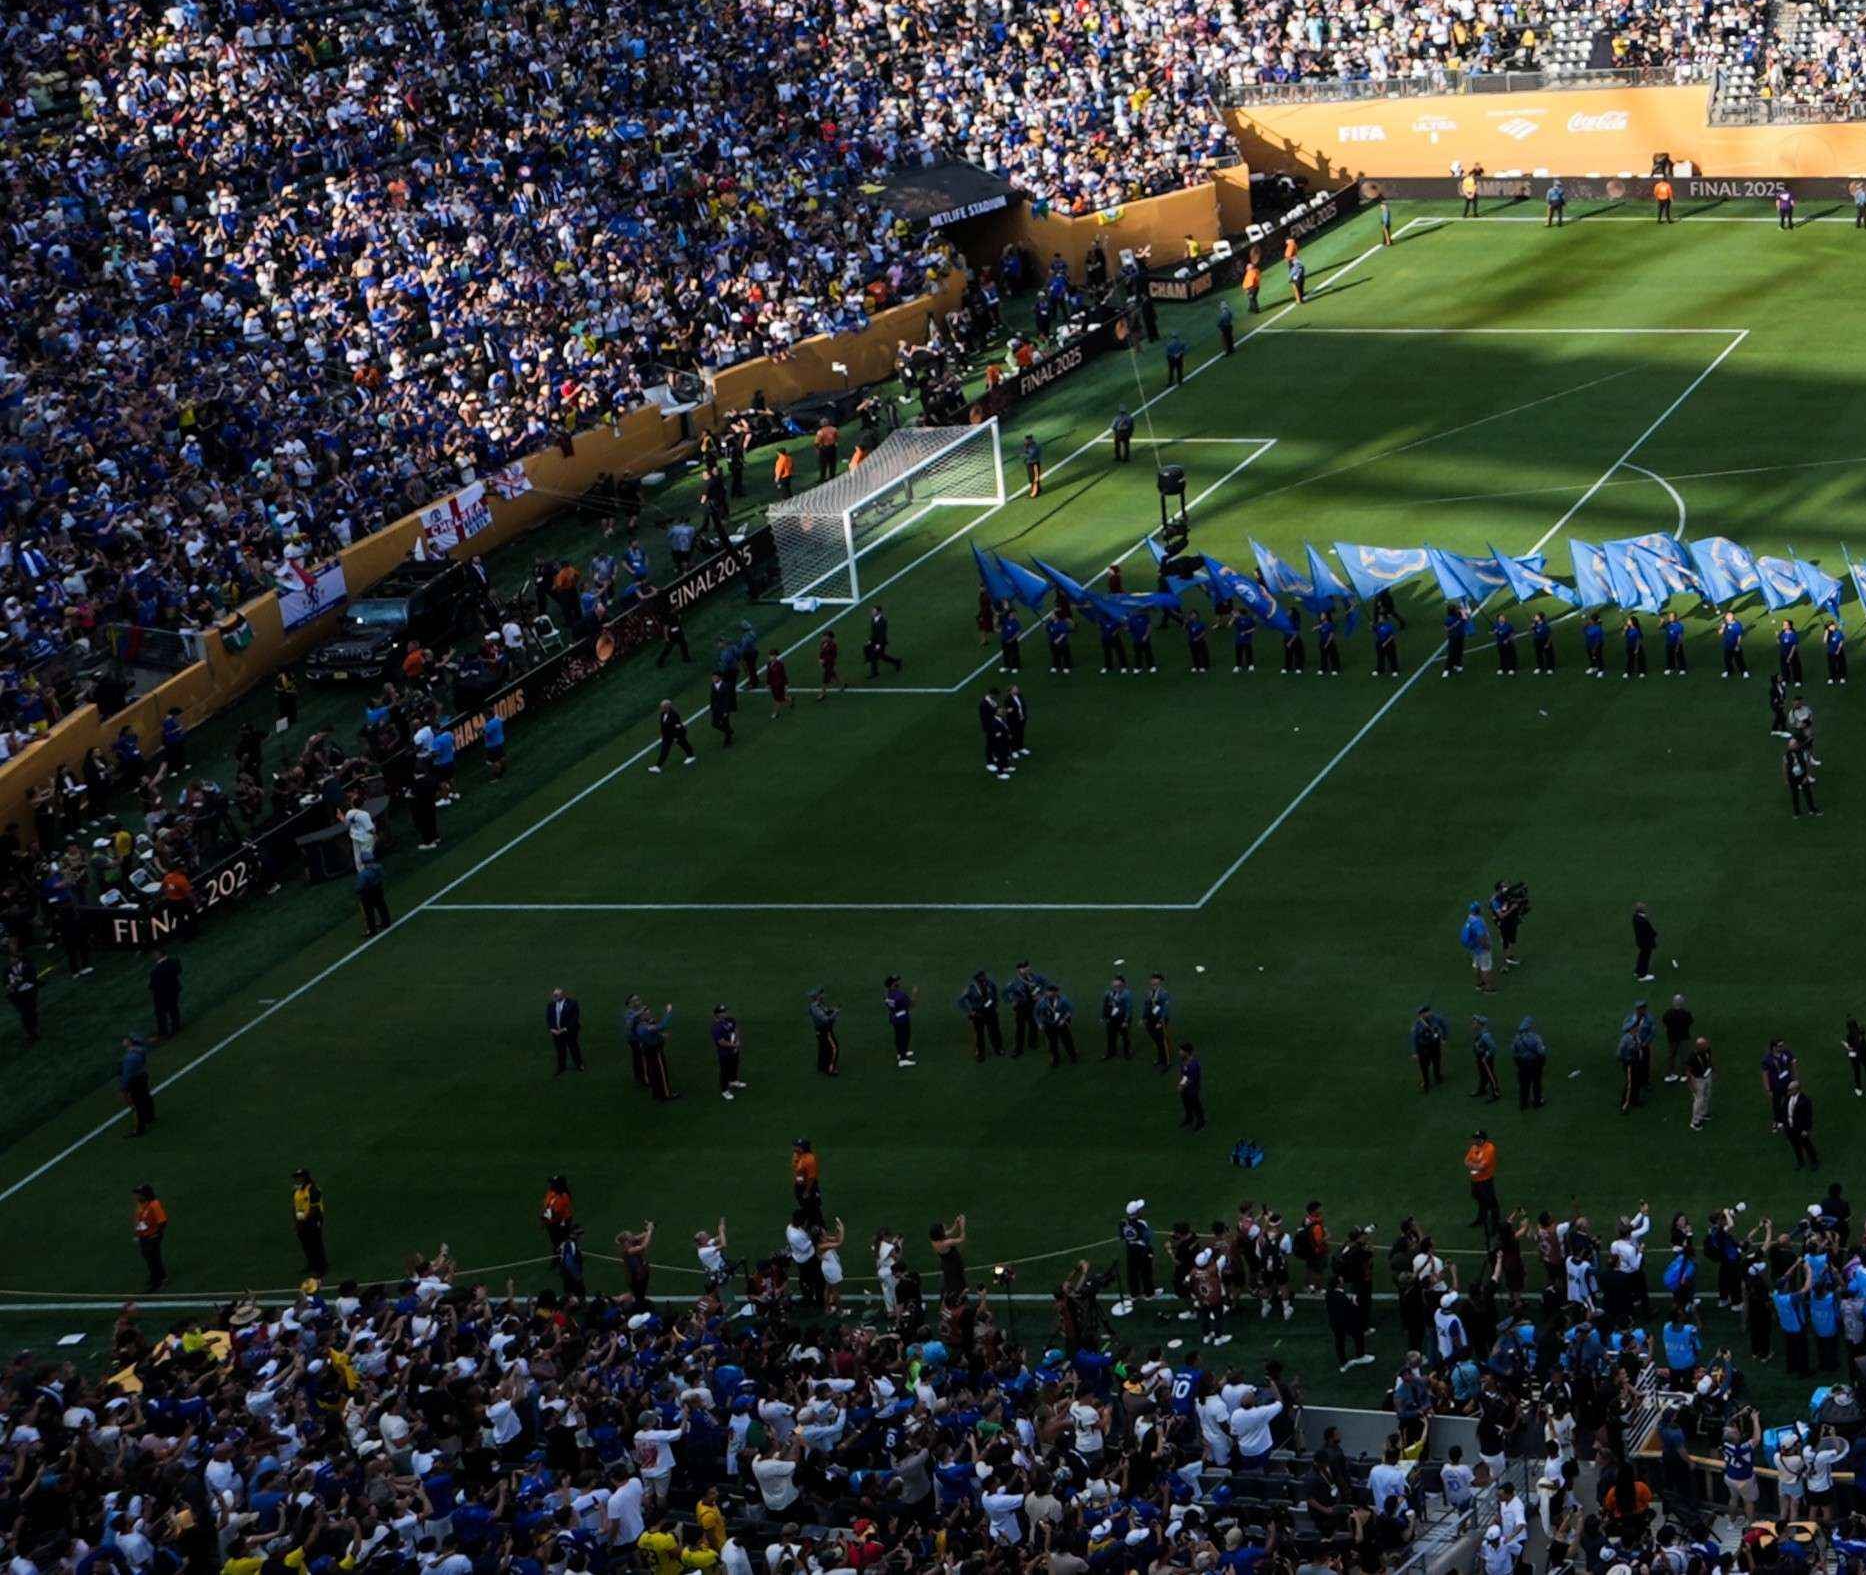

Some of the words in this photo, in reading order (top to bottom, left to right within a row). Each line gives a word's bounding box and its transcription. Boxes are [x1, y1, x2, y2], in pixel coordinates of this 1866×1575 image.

[1338, 125, 1387, 143] FIFA
[1690, 181, 1742, 197] FINAL
[929, 206, 968, 228] METLIFE
[967, 195, 1007, 218] STADIUM
[1020, 362, 1056, 396] FINAL
[1056, 345, 1083, 376] 2025
[669, 569, 717, 610] FINAL
[205, 861, 248, 907] 202
[1171, 1379, 1191, 1400] 10
[885, 1433, 897, 1448] 8
